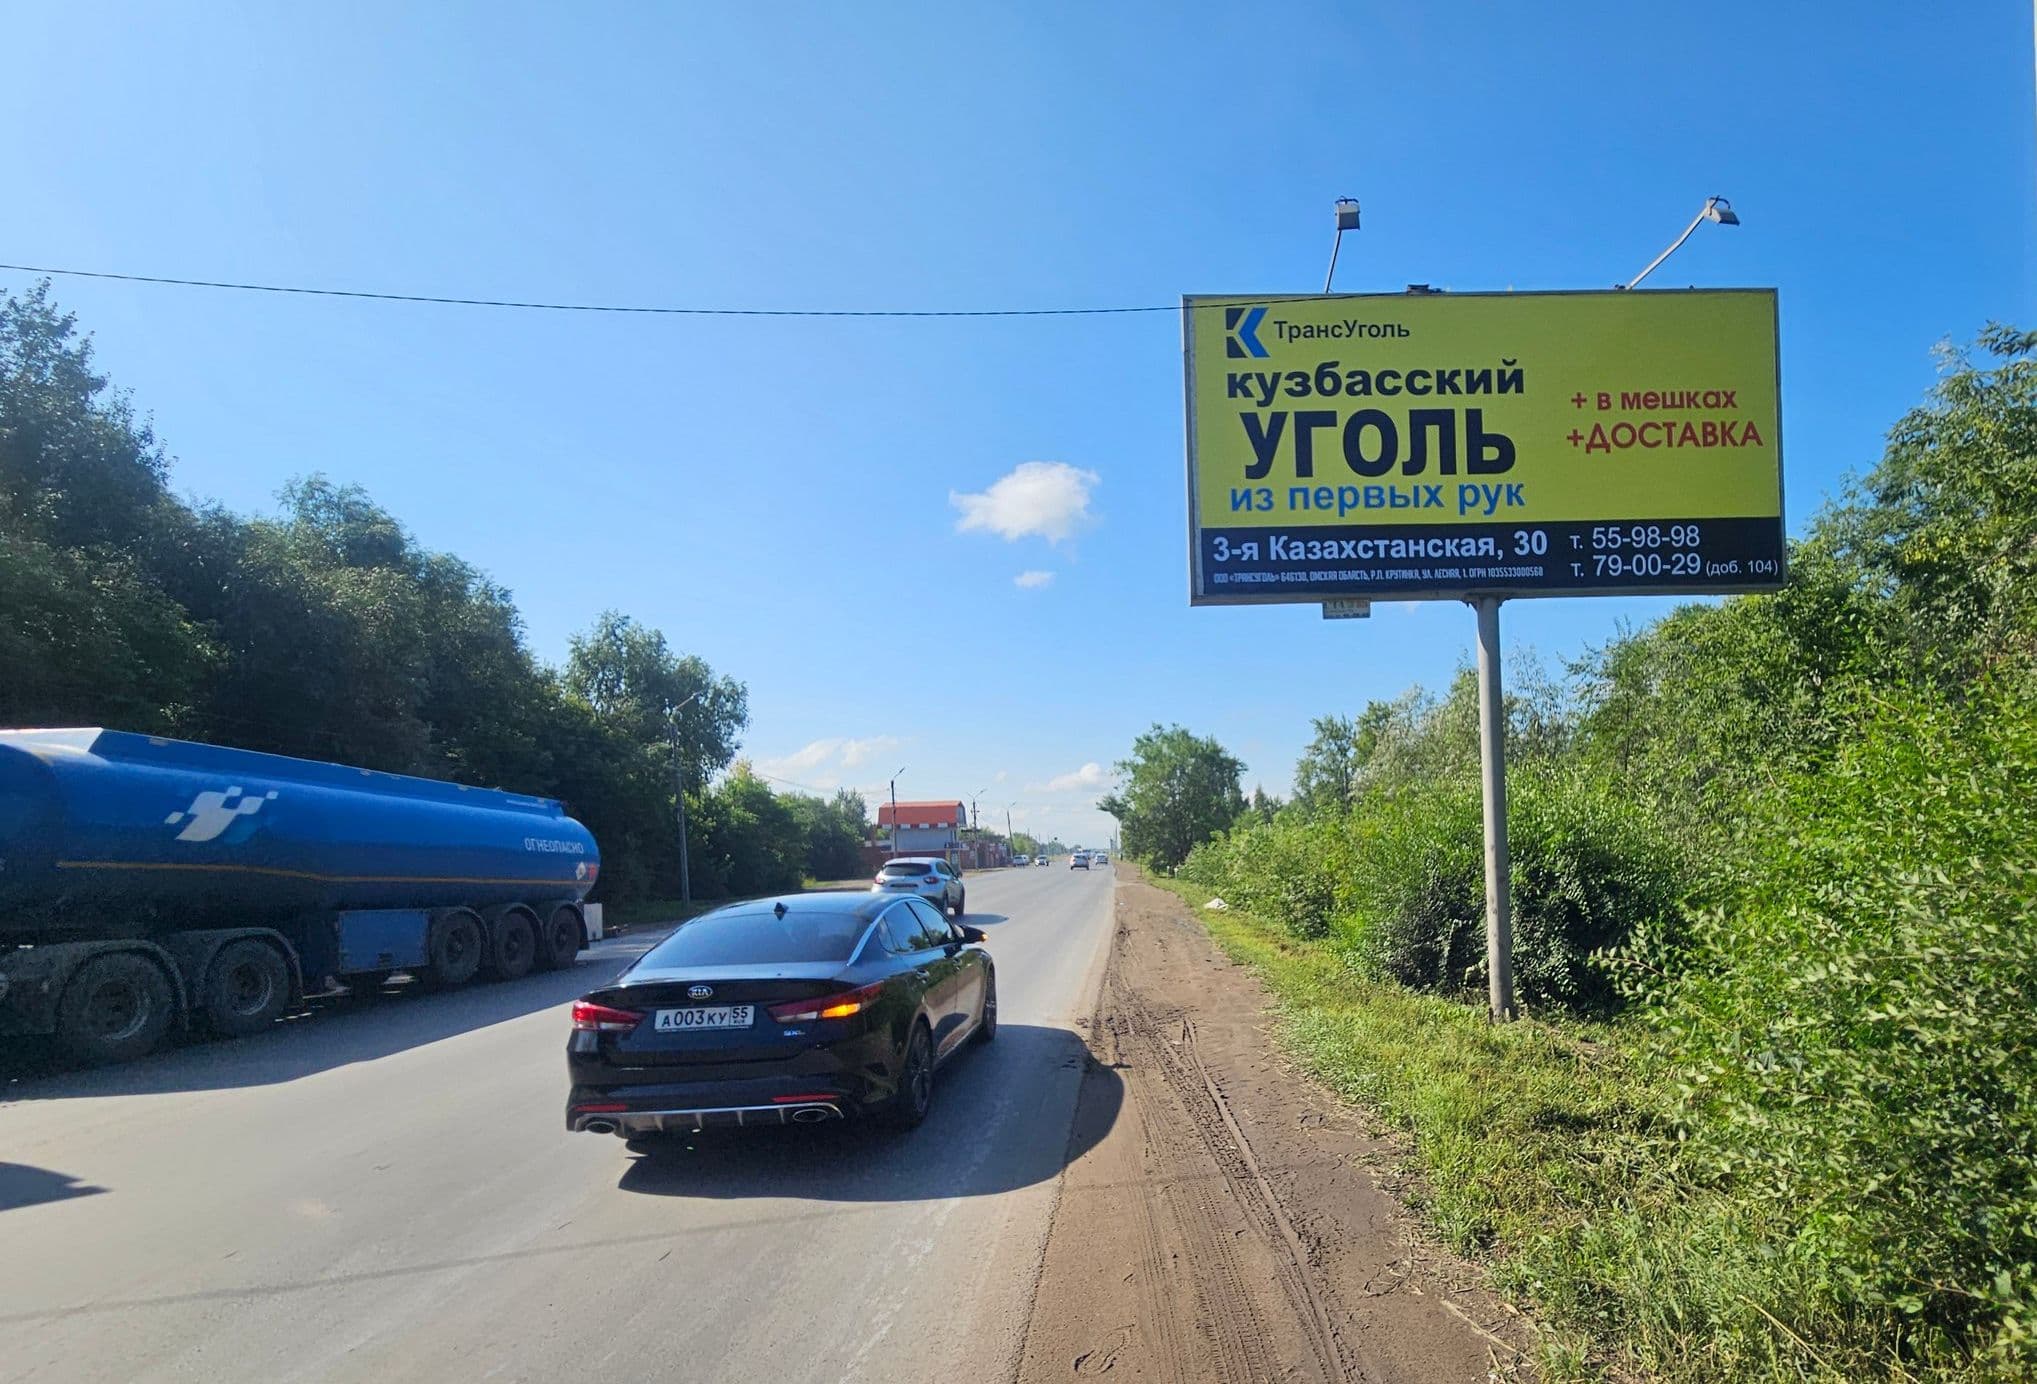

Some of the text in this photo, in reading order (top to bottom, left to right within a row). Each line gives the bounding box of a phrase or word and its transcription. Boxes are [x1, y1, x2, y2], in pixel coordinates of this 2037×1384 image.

[1273, 319, 1411, 343] ТрансУголь
[1226, 358, 1525, 408] кузбасский
[1596, 392, 1612, 411] в
[1620, 390, 1738, 411] мешках
[1239, 408, 1517, 480] УГОЛЬ
[1567, 420, 1764, 454] +ДОСТАВКА
[1230, 482, 1526, 517] из первых рук
[1213, 530, 1548, 562] 3-я Казахстанская, 30
[1569, 525, 1700, 549] т. 55-98-98
[1570, 552, 1779, 577] т. 79-00-29 (доб. 104)
[524, 837, 584, 855] ОГНЕОПАСНО
[691, 987, 709, 997] KIA
[732, 1007, 748, 1019] 55
